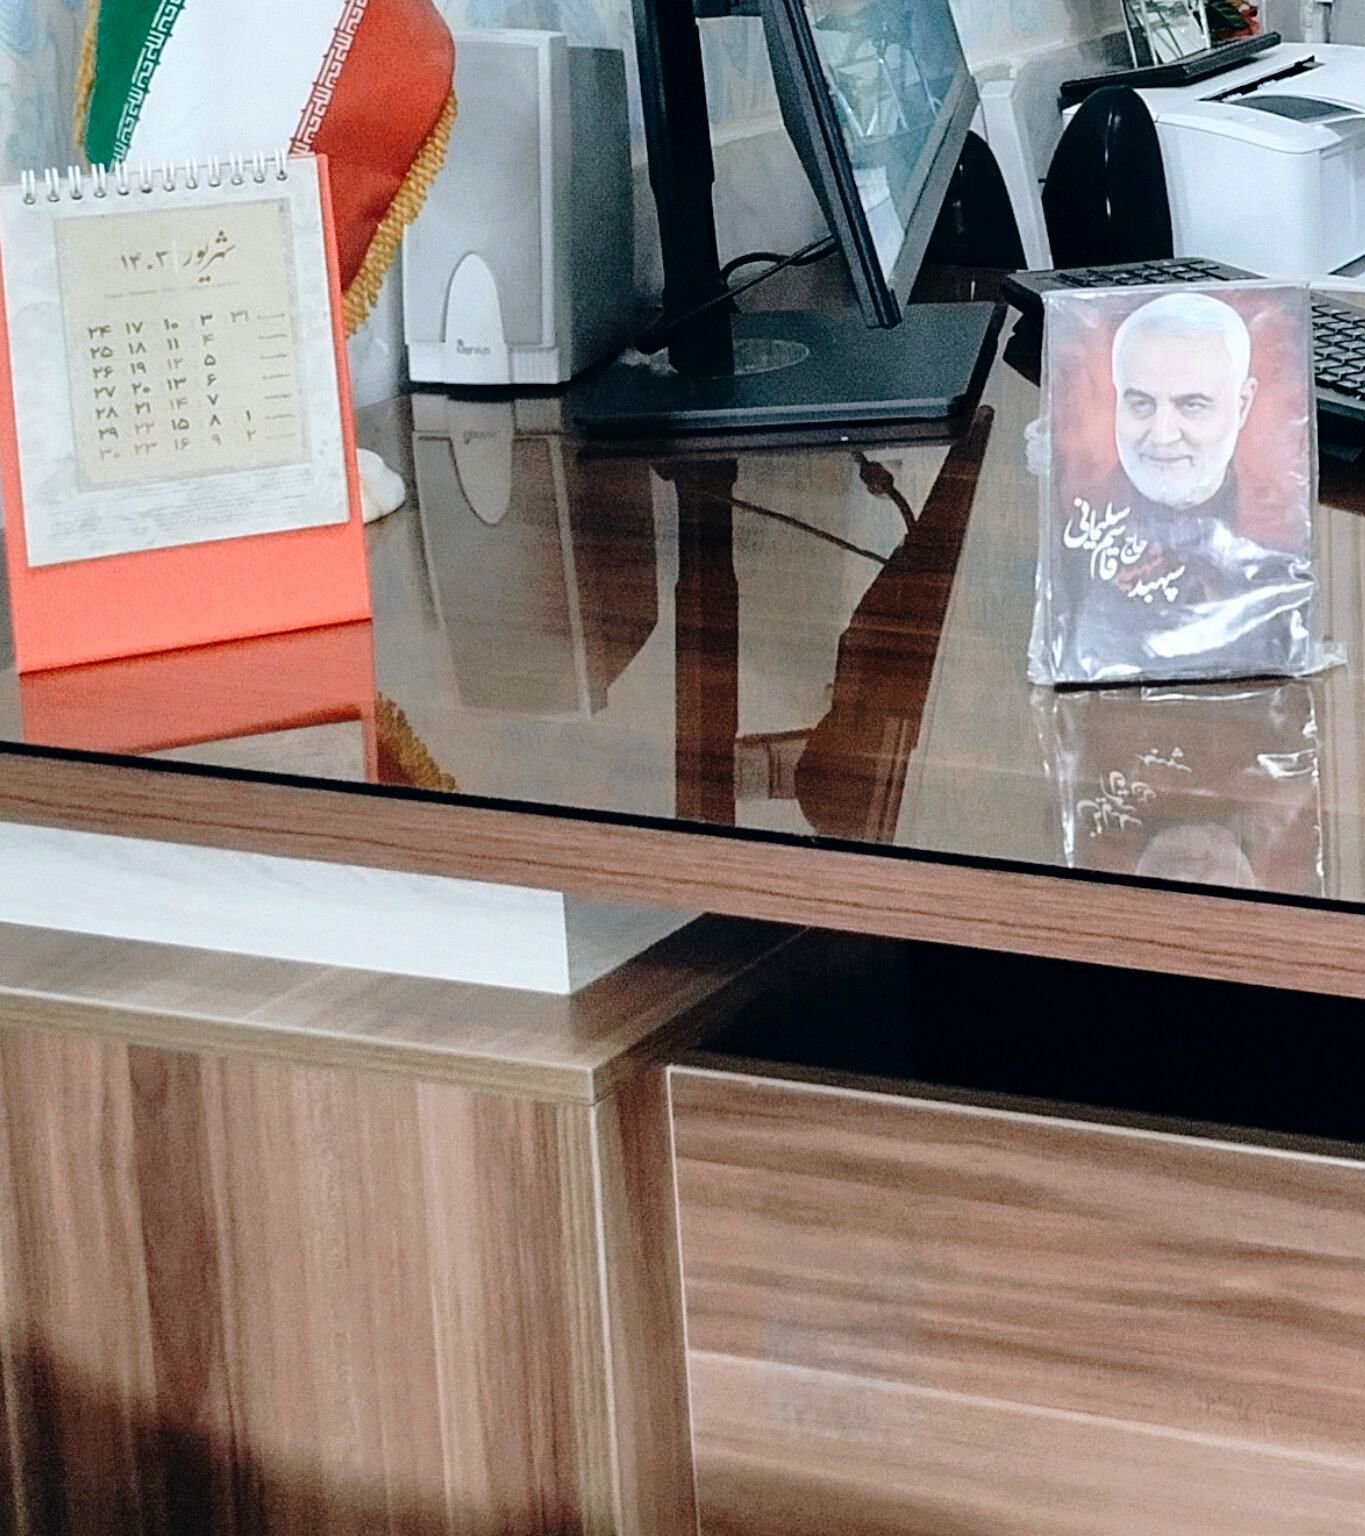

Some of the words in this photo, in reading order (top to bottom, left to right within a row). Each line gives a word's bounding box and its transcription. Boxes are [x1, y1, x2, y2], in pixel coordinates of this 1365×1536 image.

[183, 229, 236, 284] شهریور
[125, 321, 143, 335] ۱۷
[128, 342, 147, 355] ۱۸
[204, 354, 217, 366] ۵
[130, 362, 146, 374] ۱۹
[207, 394, 219, 405] ۷
[96, 406, 119, 420] ۲۸
[210, 414, 221, 426] ۸
[171, 418, 190, 431] ۱۵
[1063, 497, 1131, 549] سلیمانی
[1090, 525, 1126, 580] قاسم
[1120, 532, 1148, 565] حاج
[1127, 564, 1185, 603] سپهبد
